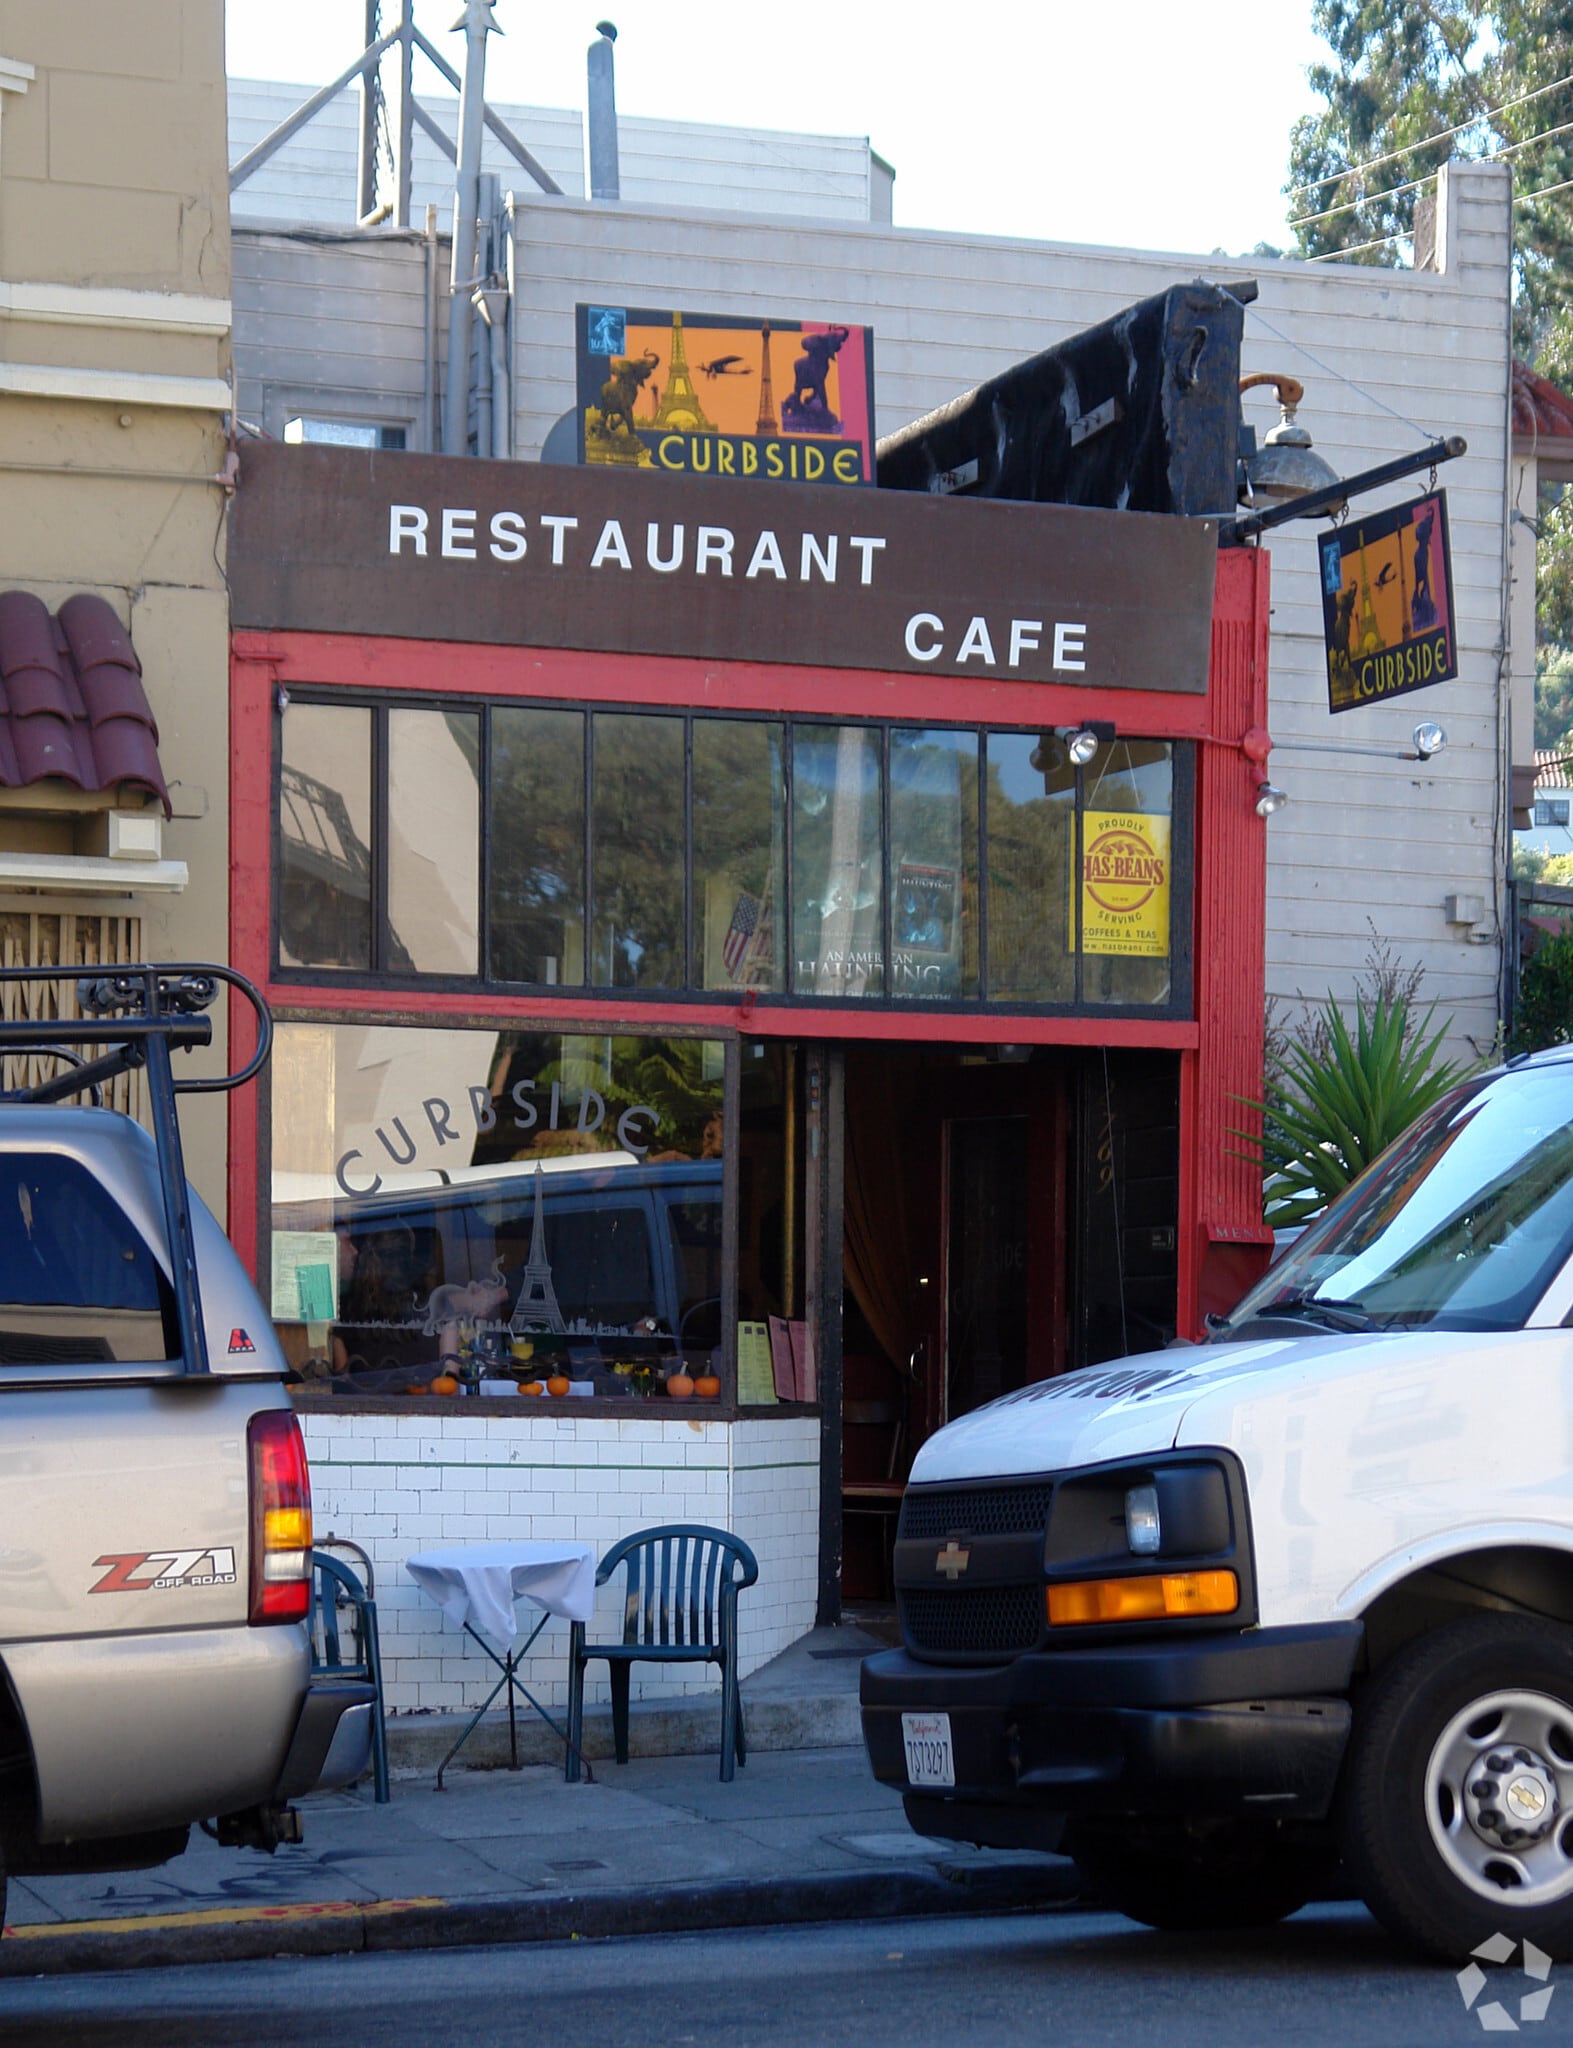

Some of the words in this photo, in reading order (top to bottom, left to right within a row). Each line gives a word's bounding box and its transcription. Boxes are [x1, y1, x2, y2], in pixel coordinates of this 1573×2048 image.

[657, 434, 861, 484] CURBSIDE
[388, 505, 887, 585] RESTAURANT
[904, 612, 1087, 672] CAFE
[1360, 636, 1448, 696] CURBSIDE
[1098, 818, 1144, 833] PROUDLY
[1097, 910, 1142, 924] SERVING
[1083, 927, 1120, 938] COFFEES
[1136, 930, 1157, 939] TEAS
[826, 951, 844, 961] AN
[847, 951, 913, 964] AMERAN
[798, 960, 940, 985] HAUNTING
[336, 1079, 661, 1198] CURBSIDE
[1215, 1226, 1269, 1239] MENU
[87, 1546, 236, 1594] Z71
[153, 1577, 185, 1588] OFF
[191, 1574, 236, 1586] ROAD
